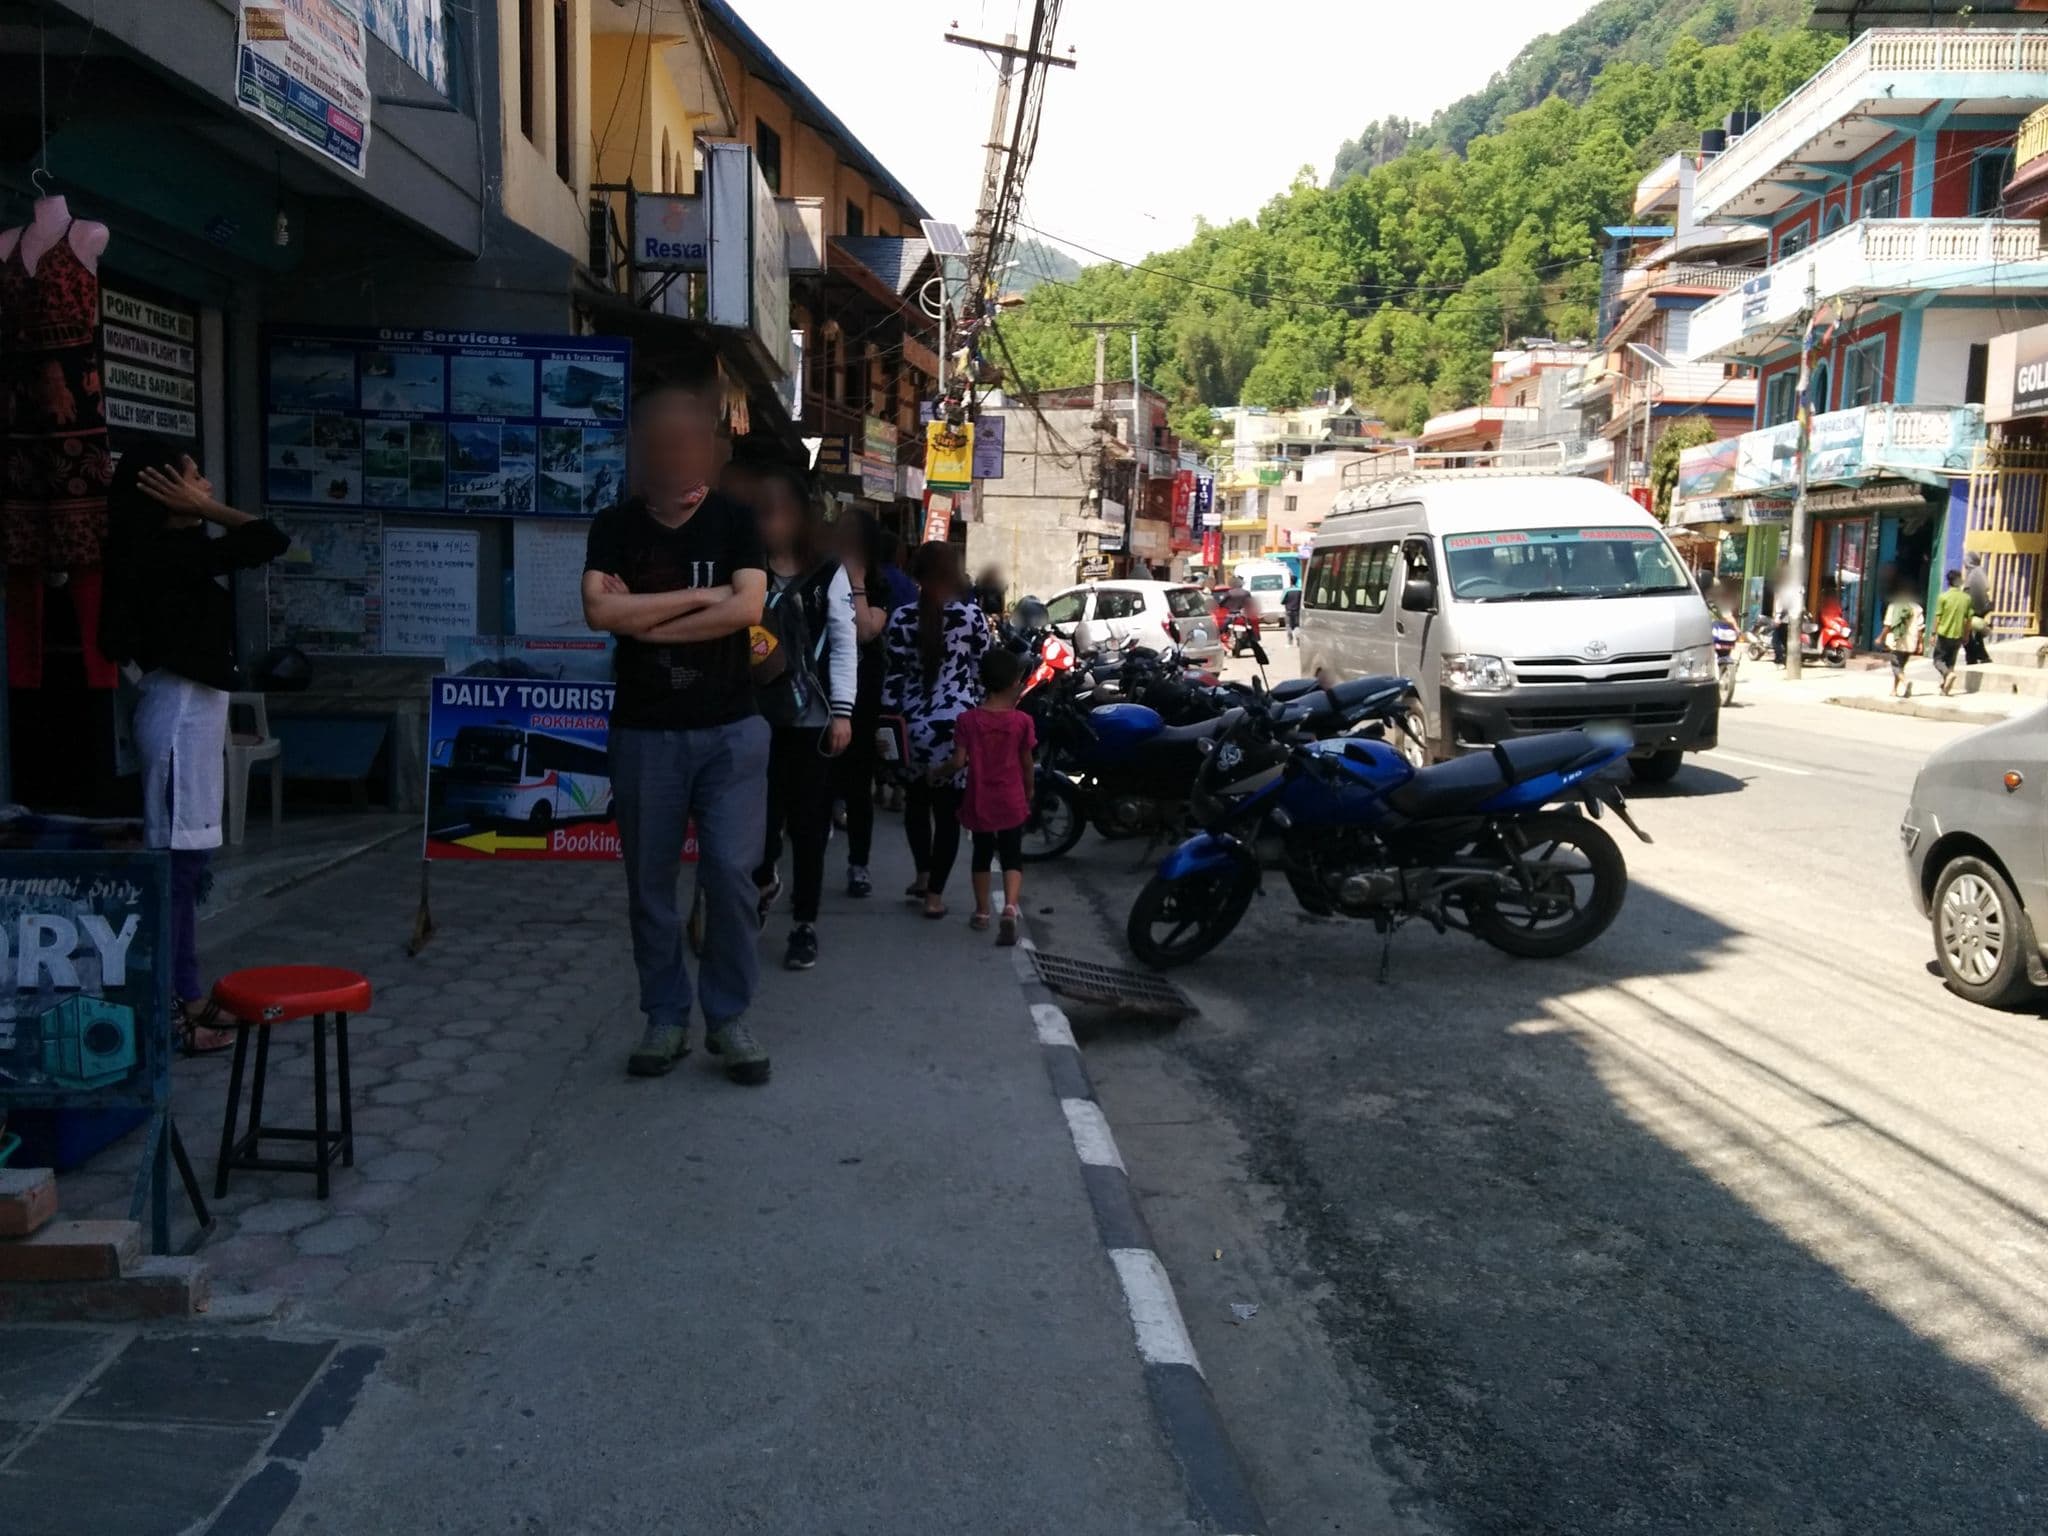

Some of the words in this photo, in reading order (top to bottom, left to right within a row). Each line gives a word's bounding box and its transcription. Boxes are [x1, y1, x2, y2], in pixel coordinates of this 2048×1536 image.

[646, 237, 706, 258] Resta
[106, 295, 142, 321] PONY
[145, 307, 176, 332] TREK
[106, 328, 149, 354] MOUNTAIN
[151, 341, 177, 363] FLIGHT
[379, 327, 414, 342] Our
[423, 330, 518, 345] Services:
[108, 367, 146, 391] JUNGLE
[149, 376, 179, 398] SAFARI
[2018, 361, 2048, 394] GOL
[108, 402, 133, 422] VALLEY
[135, 408, 154, 426] SIGHT
[156, 411, 178, 429] SEEING
[476, 415, 506, 425] Trekking
[1495, 532, 1528, 544] NEPAL
[442, 683, 510, 707] DAILY
[517, 685, 617, 711] TOURIST
[553, 829, 624, 856] Booking
